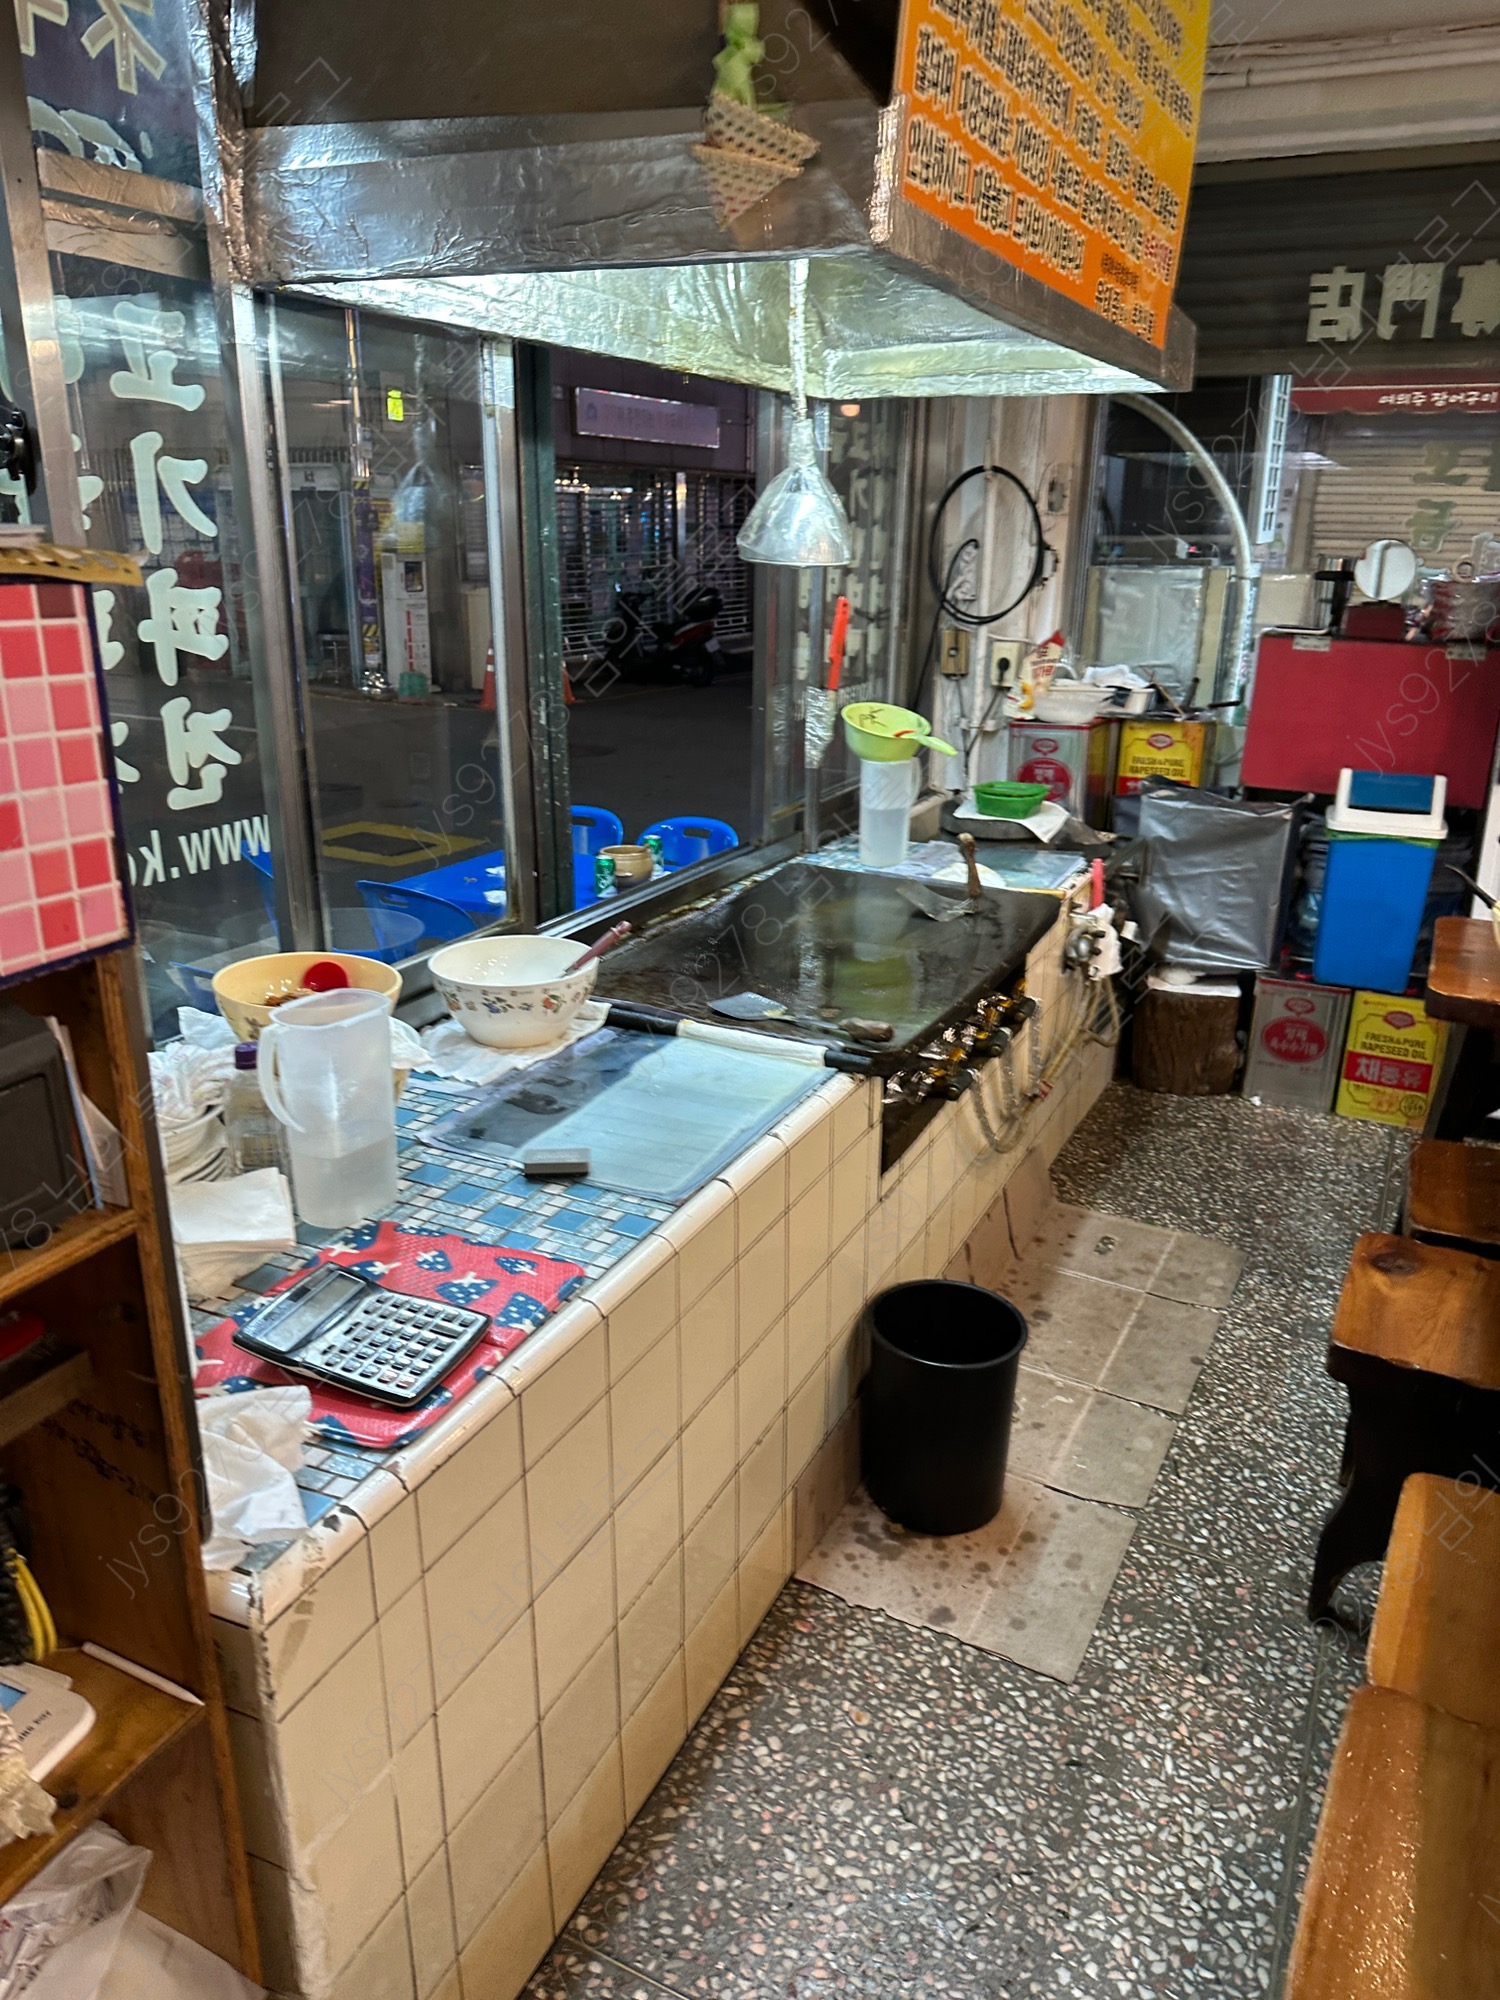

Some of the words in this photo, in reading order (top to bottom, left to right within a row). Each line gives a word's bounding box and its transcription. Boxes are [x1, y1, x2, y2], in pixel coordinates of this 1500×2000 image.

[1378, 391, 1428, 406] 여의주
[1430, 390, 1499, 408] 장어구이
[1411, 1050, 1428, 1061] OIL
